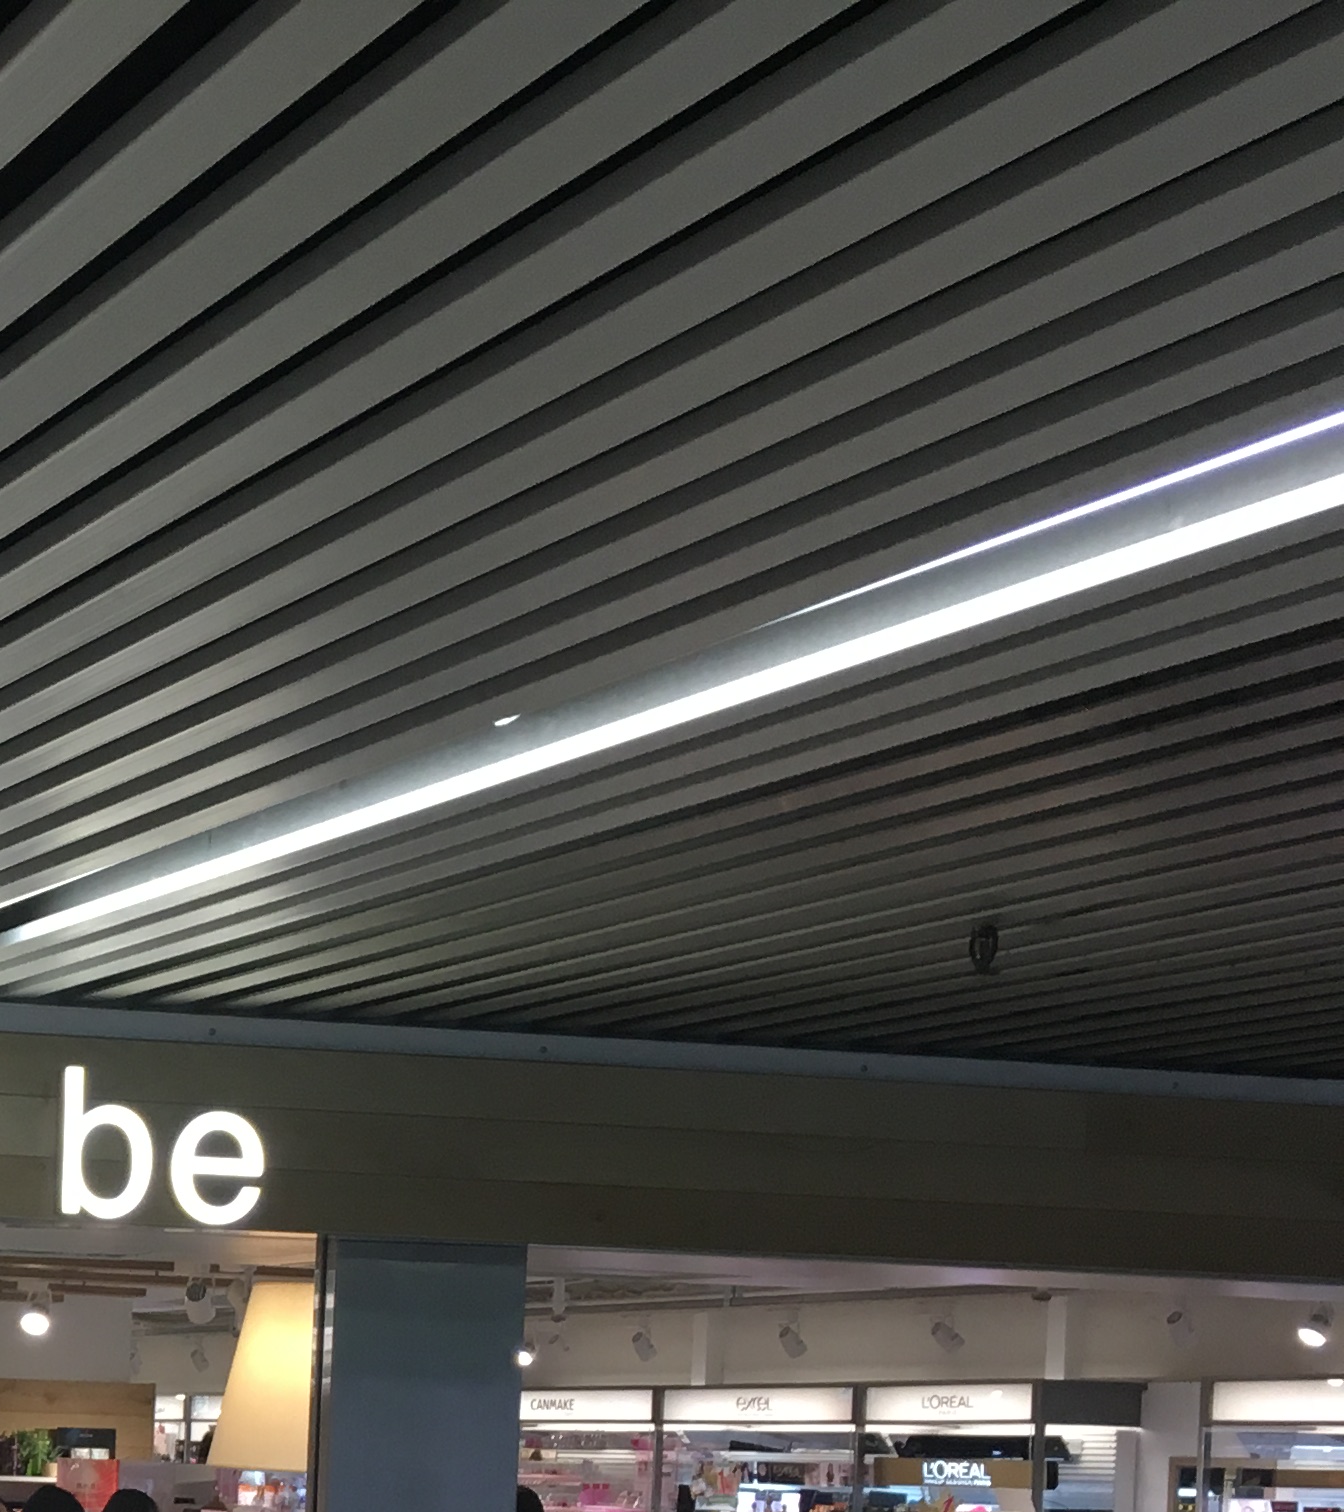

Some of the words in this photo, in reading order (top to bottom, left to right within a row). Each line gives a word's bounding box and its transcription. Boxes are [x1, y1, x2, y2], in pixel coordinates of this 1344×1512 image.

[62, 1065, 266, 1226] be
[530, 1398, 575, 1410] CANMAKE
[922, 1460, 991, 1479] L'ORÉAL
